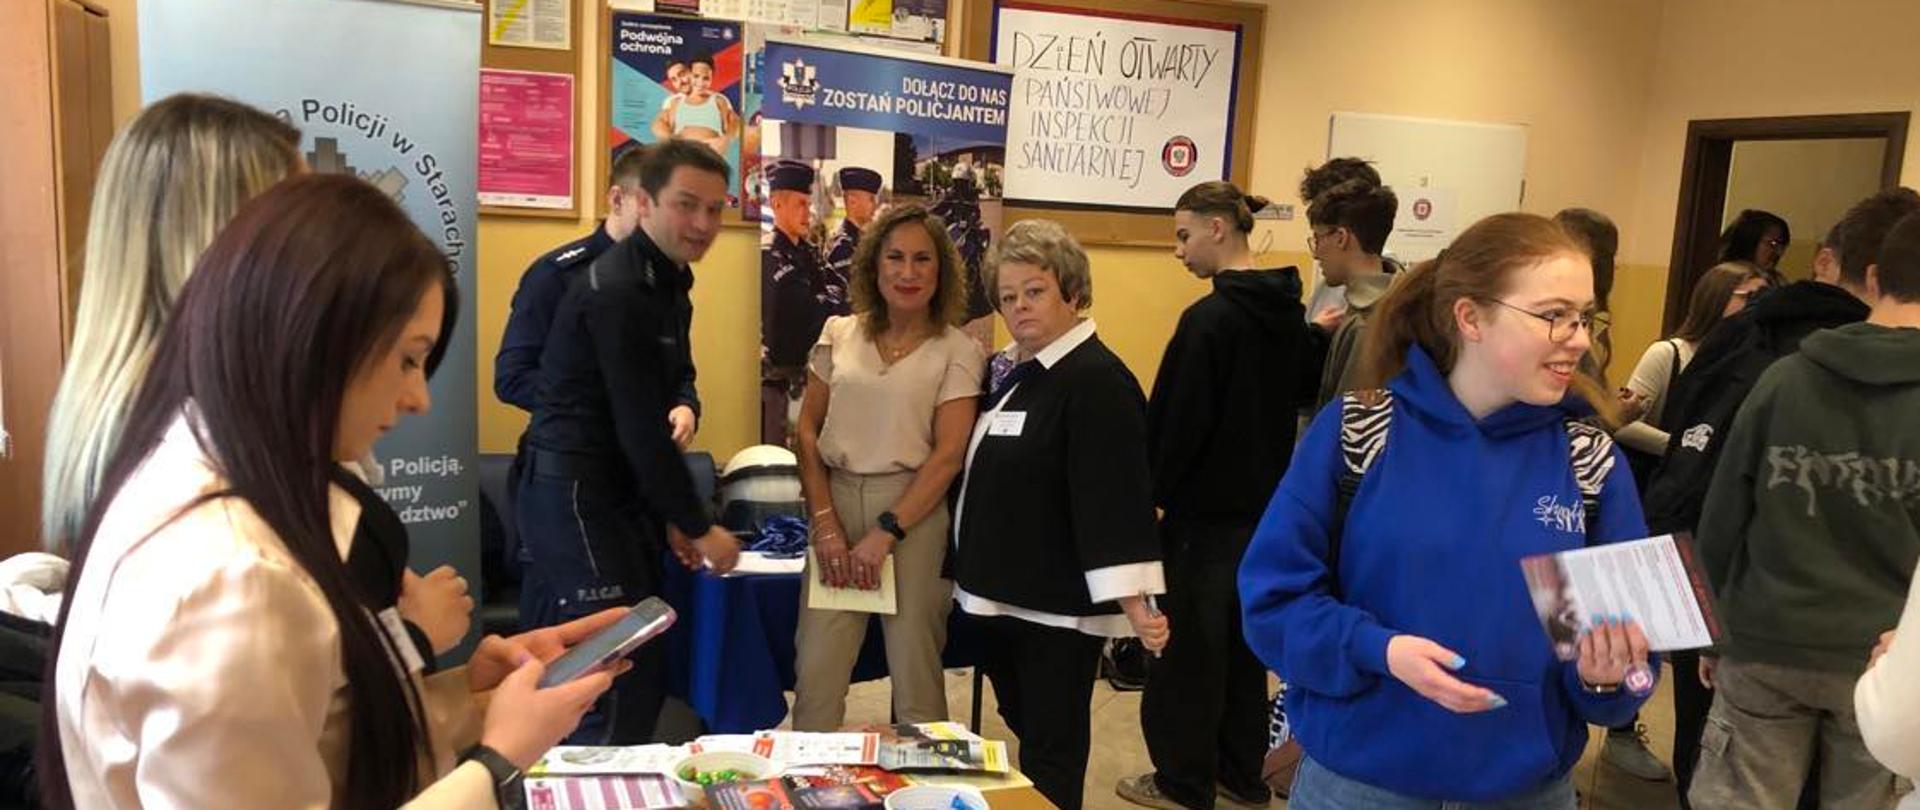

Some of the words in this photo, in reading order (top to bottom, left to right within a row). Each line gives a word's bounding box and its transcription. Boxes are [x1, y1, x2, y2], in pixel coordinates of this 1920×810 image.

[620, 28, 684, 46] Podwójna
[620, 41, 672, 55] ochrona
[1120, 37, 1218, 89] OTWARTY
[902, 77, 955, 104] DOŁĄCZ
[959, 85, 978, 103] DO
[981, 86, 1007, 106] NAS
[1026, 76, 1171, 119] PAŃSTWOWEJ
[822, 88, 892, 115] ZOSTAŃ
[896, 97, 1006, 127] POLICJANTEM
[1030, 111, 1135, 145] INSPEKCJI
[302, 99, 388, 139] Policji
[392, 132, 414, 155] w
[415, 153, 465, 274] Staracho
[390, 455, 464, 476] Policją.
[374, 485, 422, 504] ymy
[400, 500, 468, 524] dztwo”
